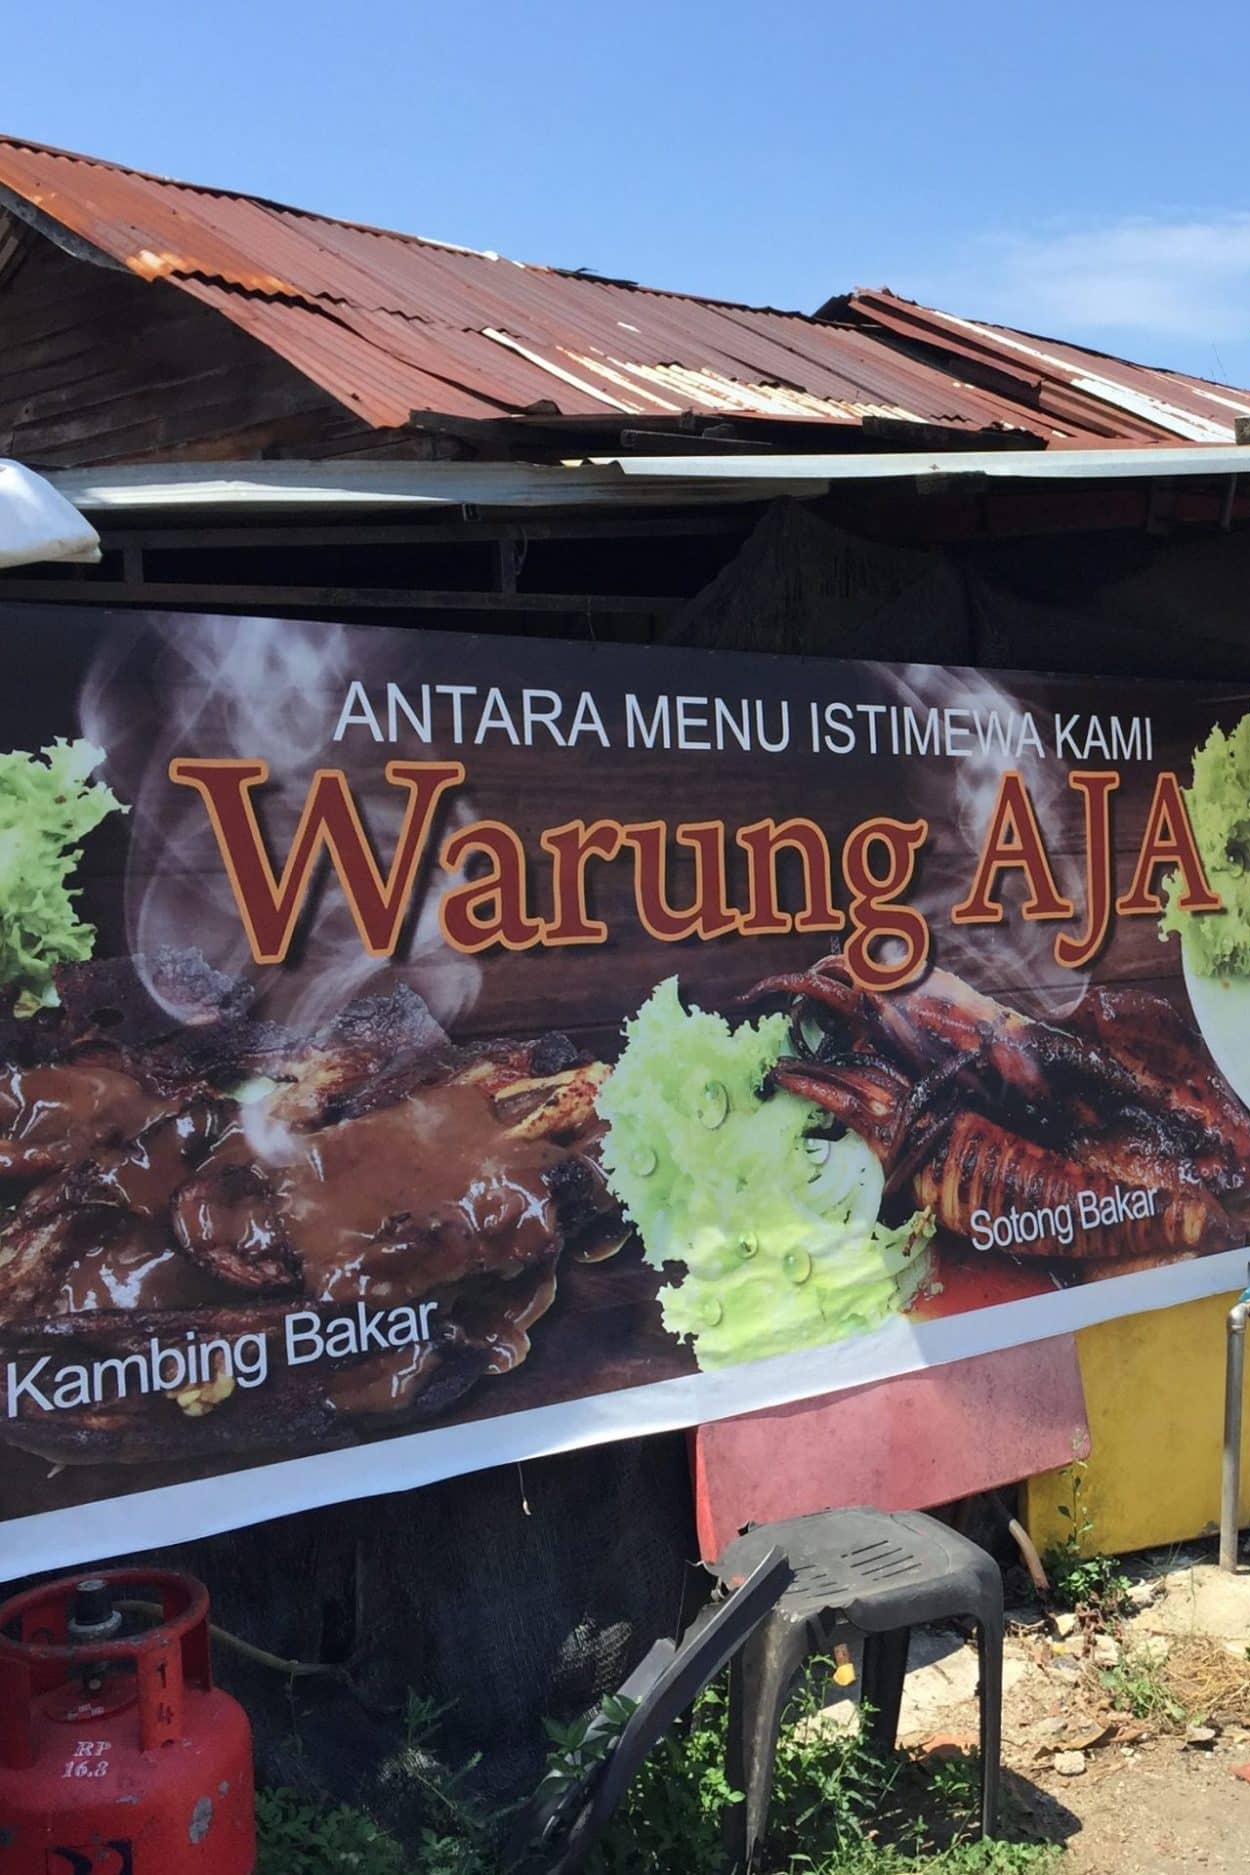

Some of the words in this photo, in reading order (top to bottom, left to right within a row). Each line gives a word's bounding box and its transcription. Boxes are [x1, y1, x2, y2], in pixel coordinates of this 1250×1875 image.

[333, 681, 610, 747] ANTARA
[625, 693, 790, 752] MENU
[810, 702, 1045, 758] ISTIMEWA
[1055, 713, 1152, 760] KAMI
[169, 757, 929, 991] Warung
[951, 769, 1222, 968] AJA
[970, 1204, 1074, 1251] Sotong
[1077, 1185, 1158, 1230] Bakar
[7, 1331, 267, 1418] Kambing
[285, 1301, 438, 1366] Bakar
[72, 1740, 112, 1756] RP
